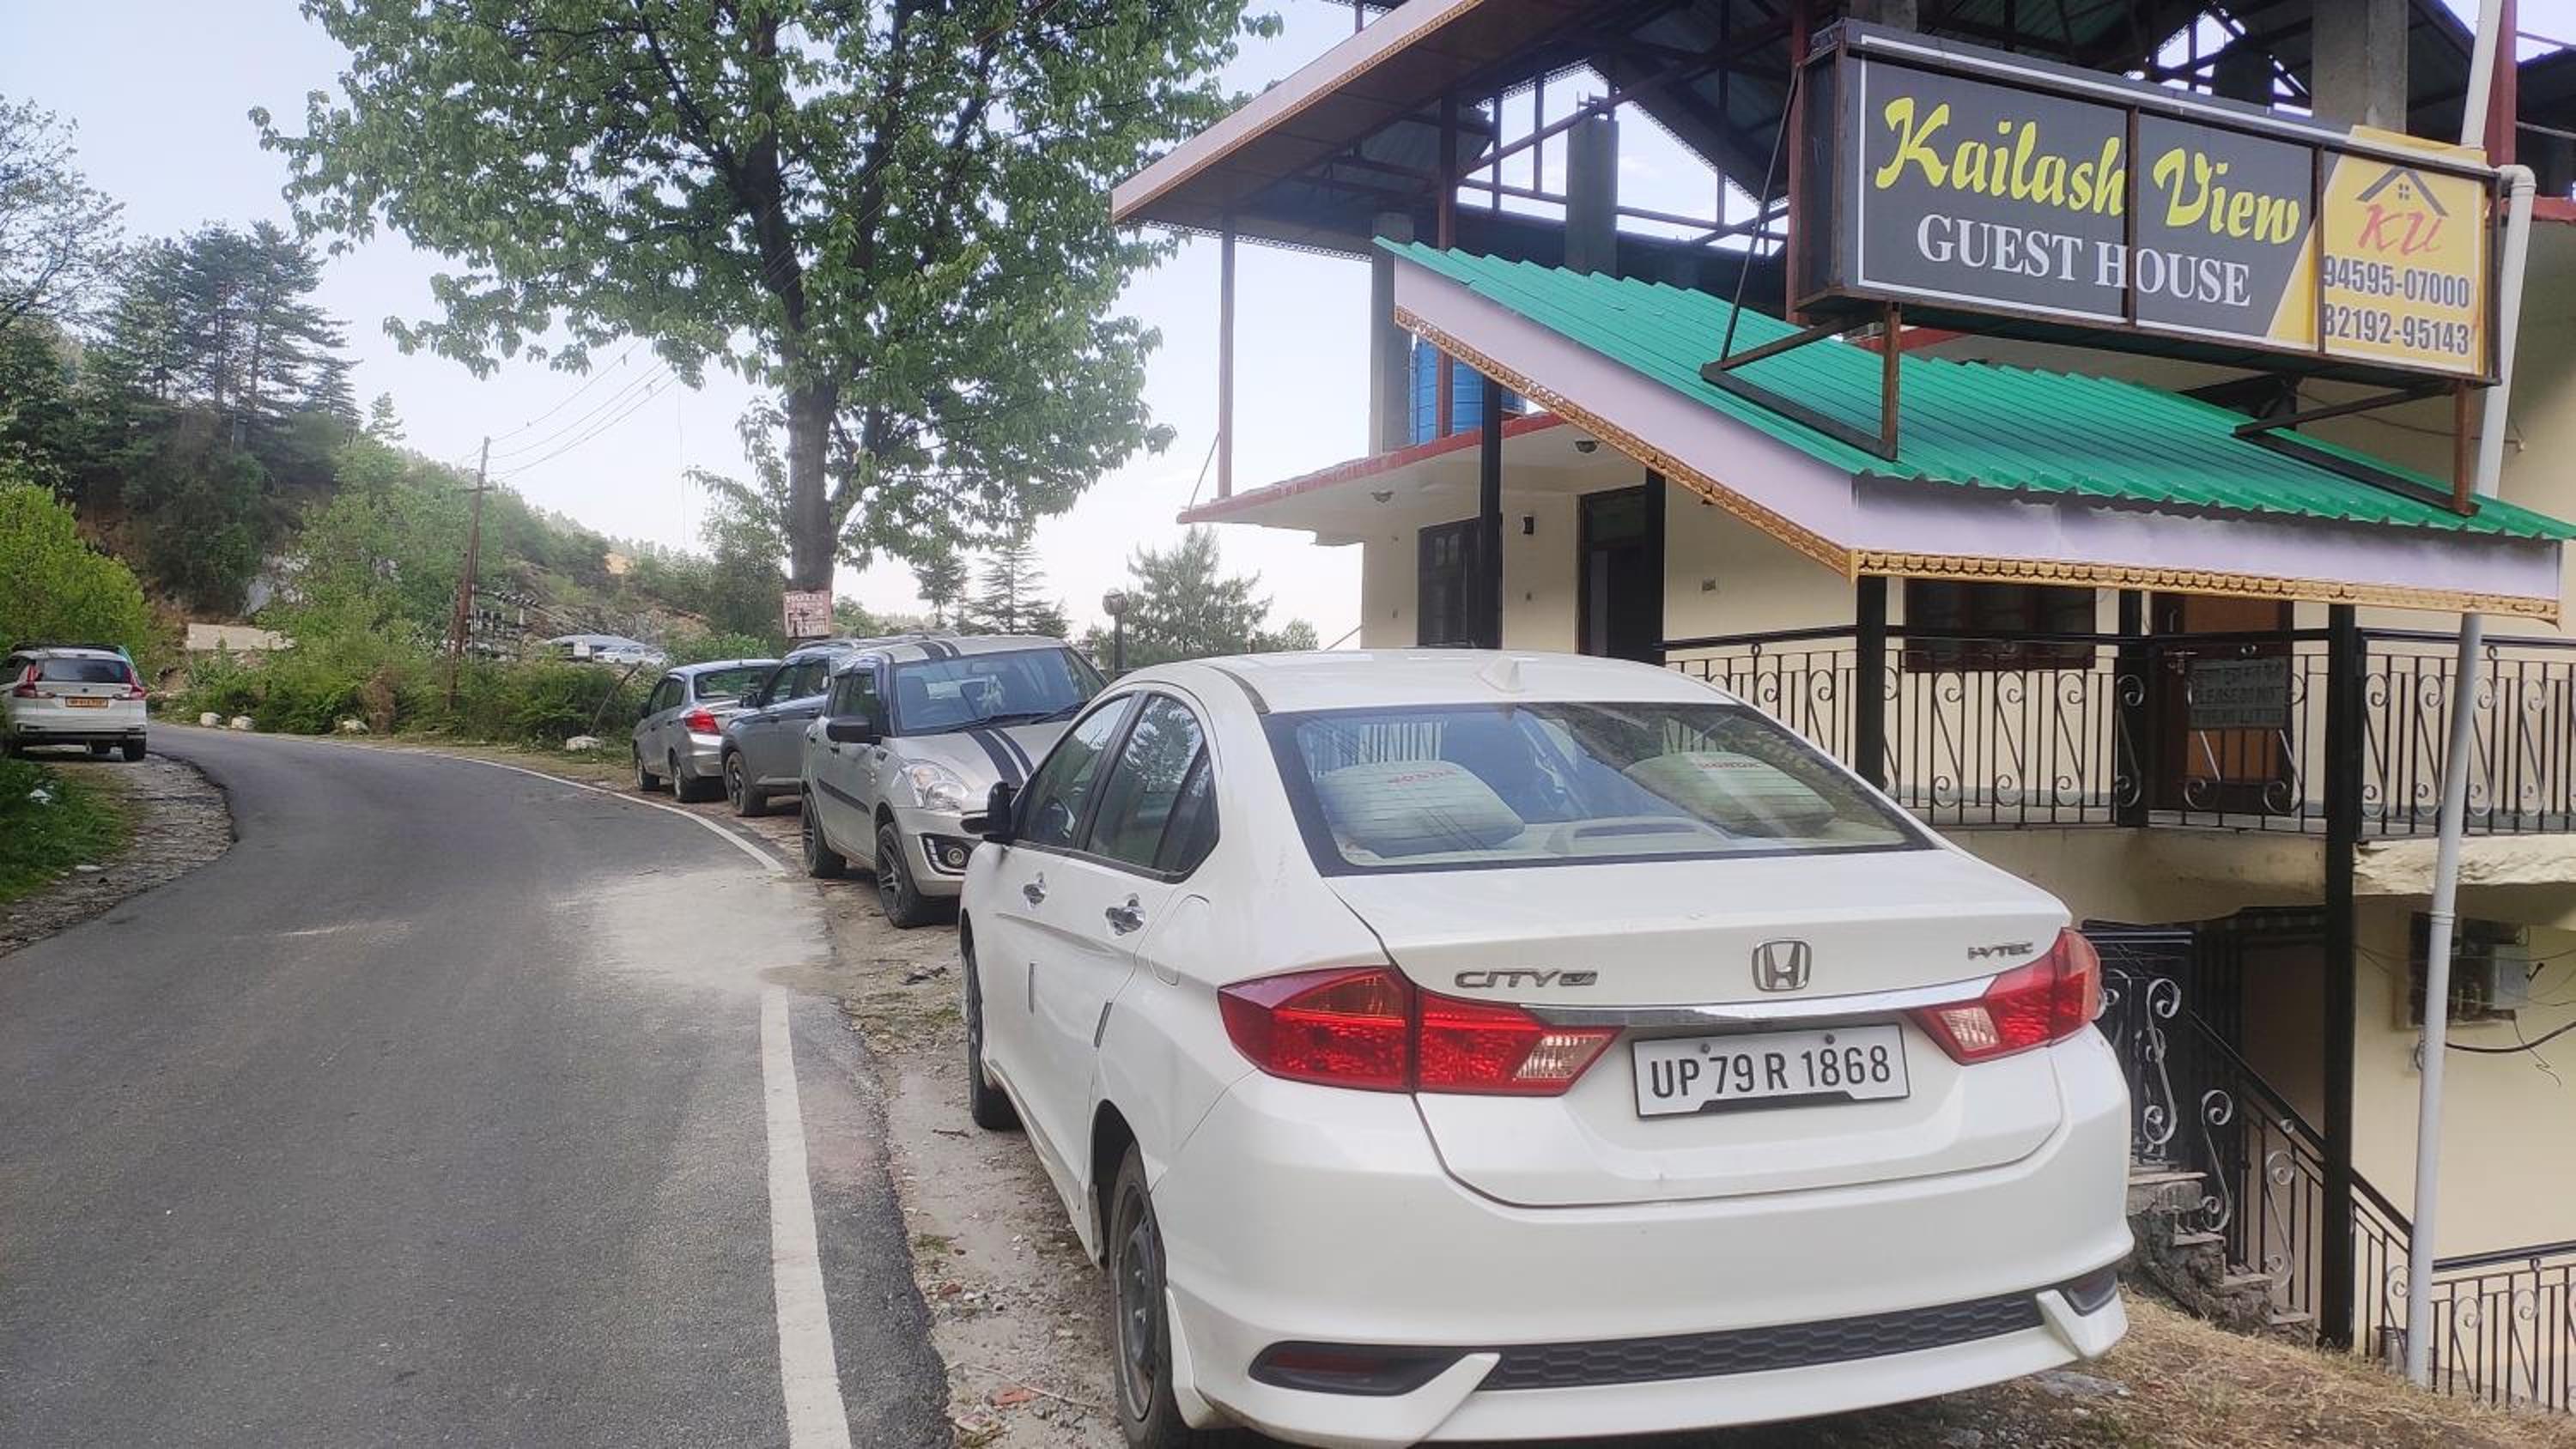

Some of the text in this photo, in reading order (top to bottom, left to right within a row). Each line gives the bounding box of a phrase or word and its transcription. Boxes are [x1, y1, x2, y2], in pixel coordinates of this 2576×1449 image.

[1875, 97, 2300, 245] Kailash View
[1917, 214, 2251, 306] GUEST HOUSE
[2323, 255, 2470, 309] 94595-07000
[1455, 970, 1562, 989] CITY
[1765, 1052, 1789, 1091] R
[1800, 1044, 1891, 1088] 1868
